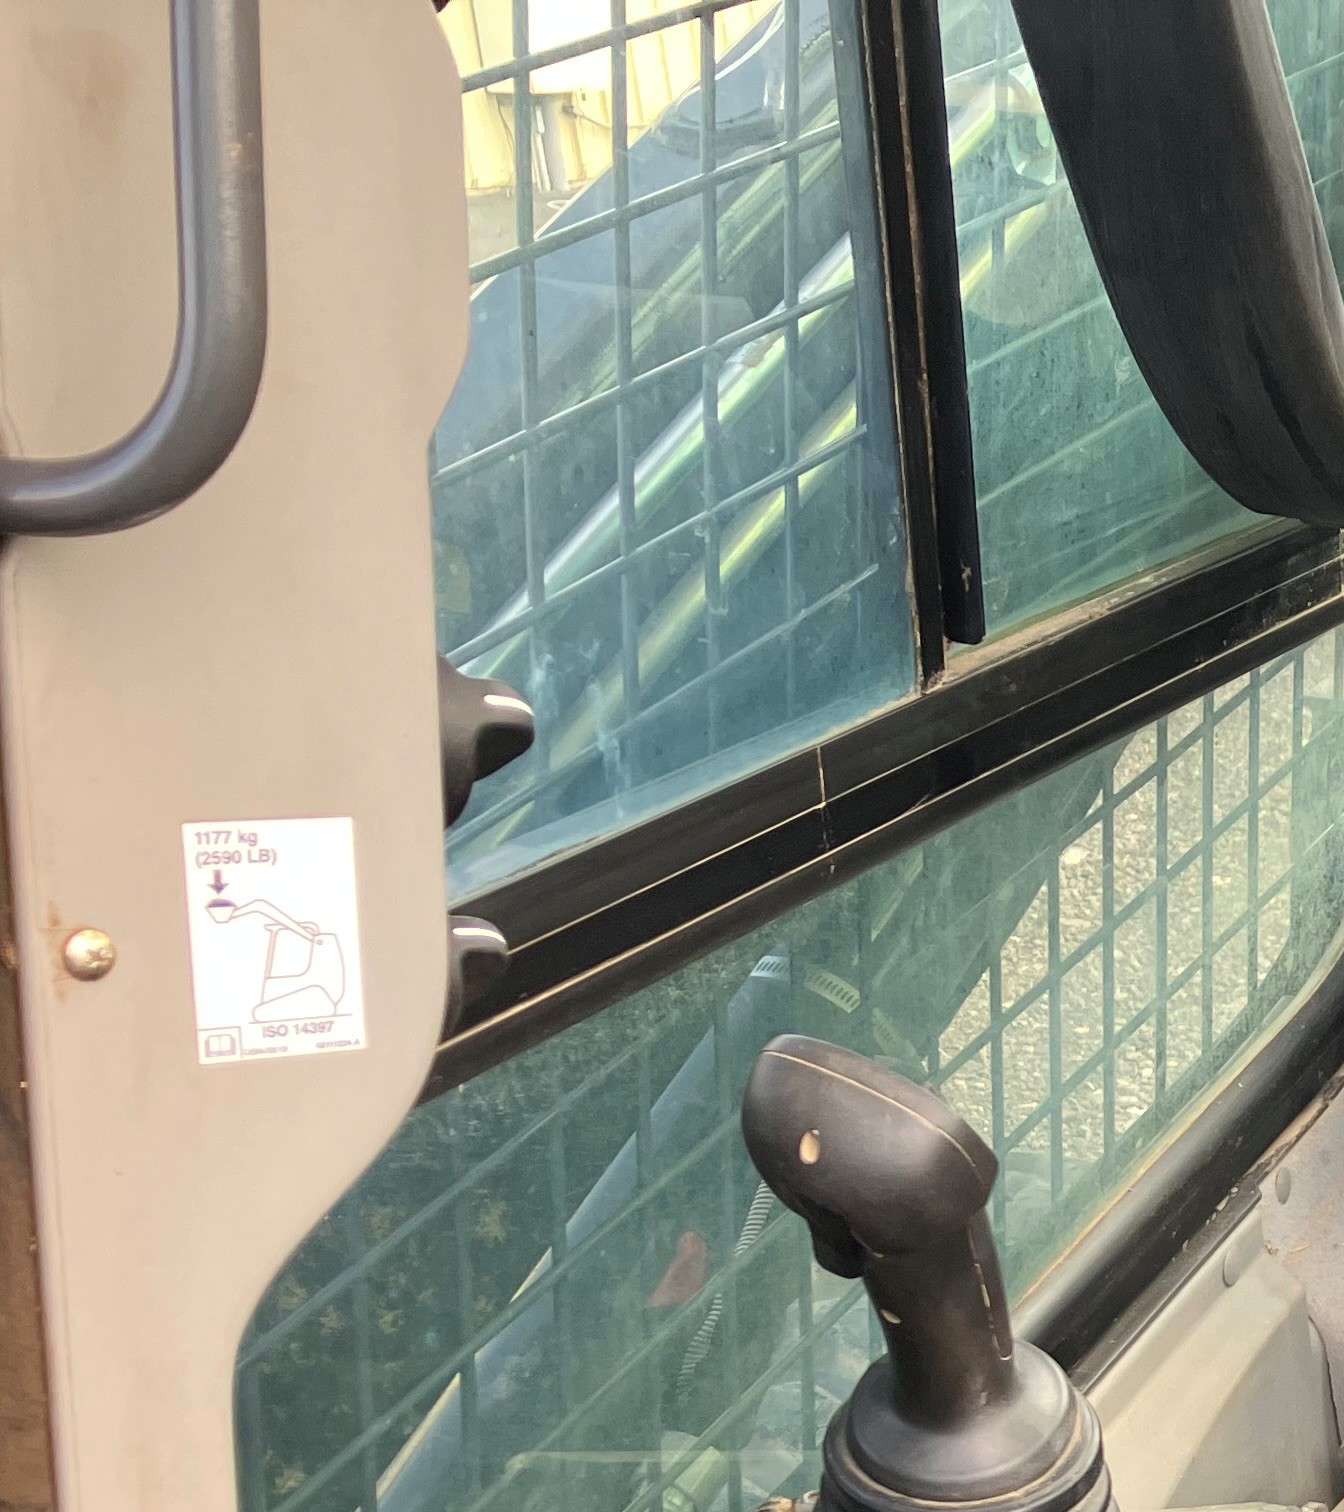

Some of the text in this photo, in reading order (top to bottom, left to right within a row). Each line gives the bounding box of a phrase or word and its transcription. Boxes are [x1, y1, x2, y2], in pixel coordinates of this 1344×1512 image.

[195, 830, 258, 846] 1177 kg
[195, 848, 277, 868] (2590 LB)
[262, 1021, 334, 1038] ISO 14397
